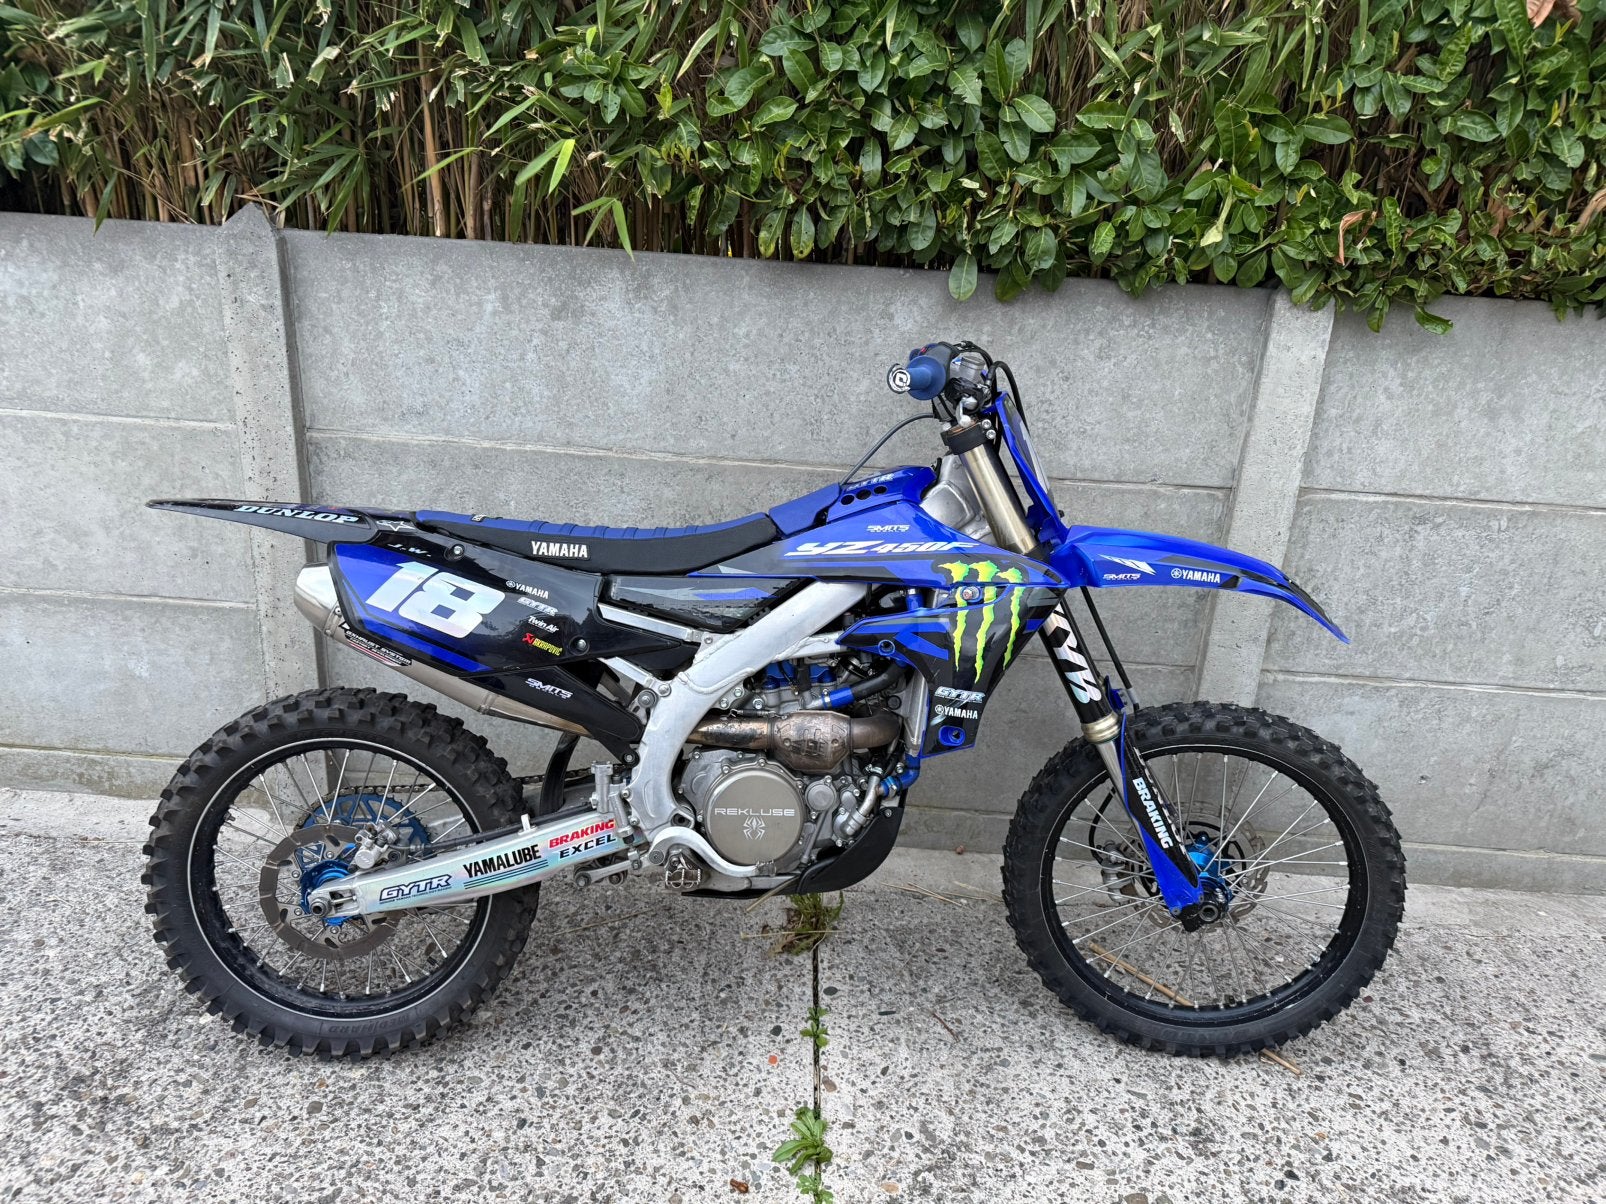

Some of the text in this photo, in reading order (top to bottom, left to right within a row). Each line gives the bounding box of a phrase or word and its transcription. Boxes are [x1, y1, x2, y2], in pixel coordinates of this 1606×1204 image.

[233, 504, 359, 524] DUNLOP
[531, 540, 588, 559] YAMAHA
[1182, 569, 1221, 584] YAMAHA
[365, 561, 506, 639] 18
[515, 583, 549, 599] YAMAHA
[528, 615, 560, 634] Twin Air
[944, 705, 978, 720] YAMAHA
[714, 807, 796, 817] REKLUSE
[1132, 776, 1174, 849] BRAKING
[549, 818, 616, 849] BRAKING
[559, 834, 617, 859] EXCEL
[463, 844, 542, 879] YAMALUBE
[380, 874, 452, 902] GYTR
